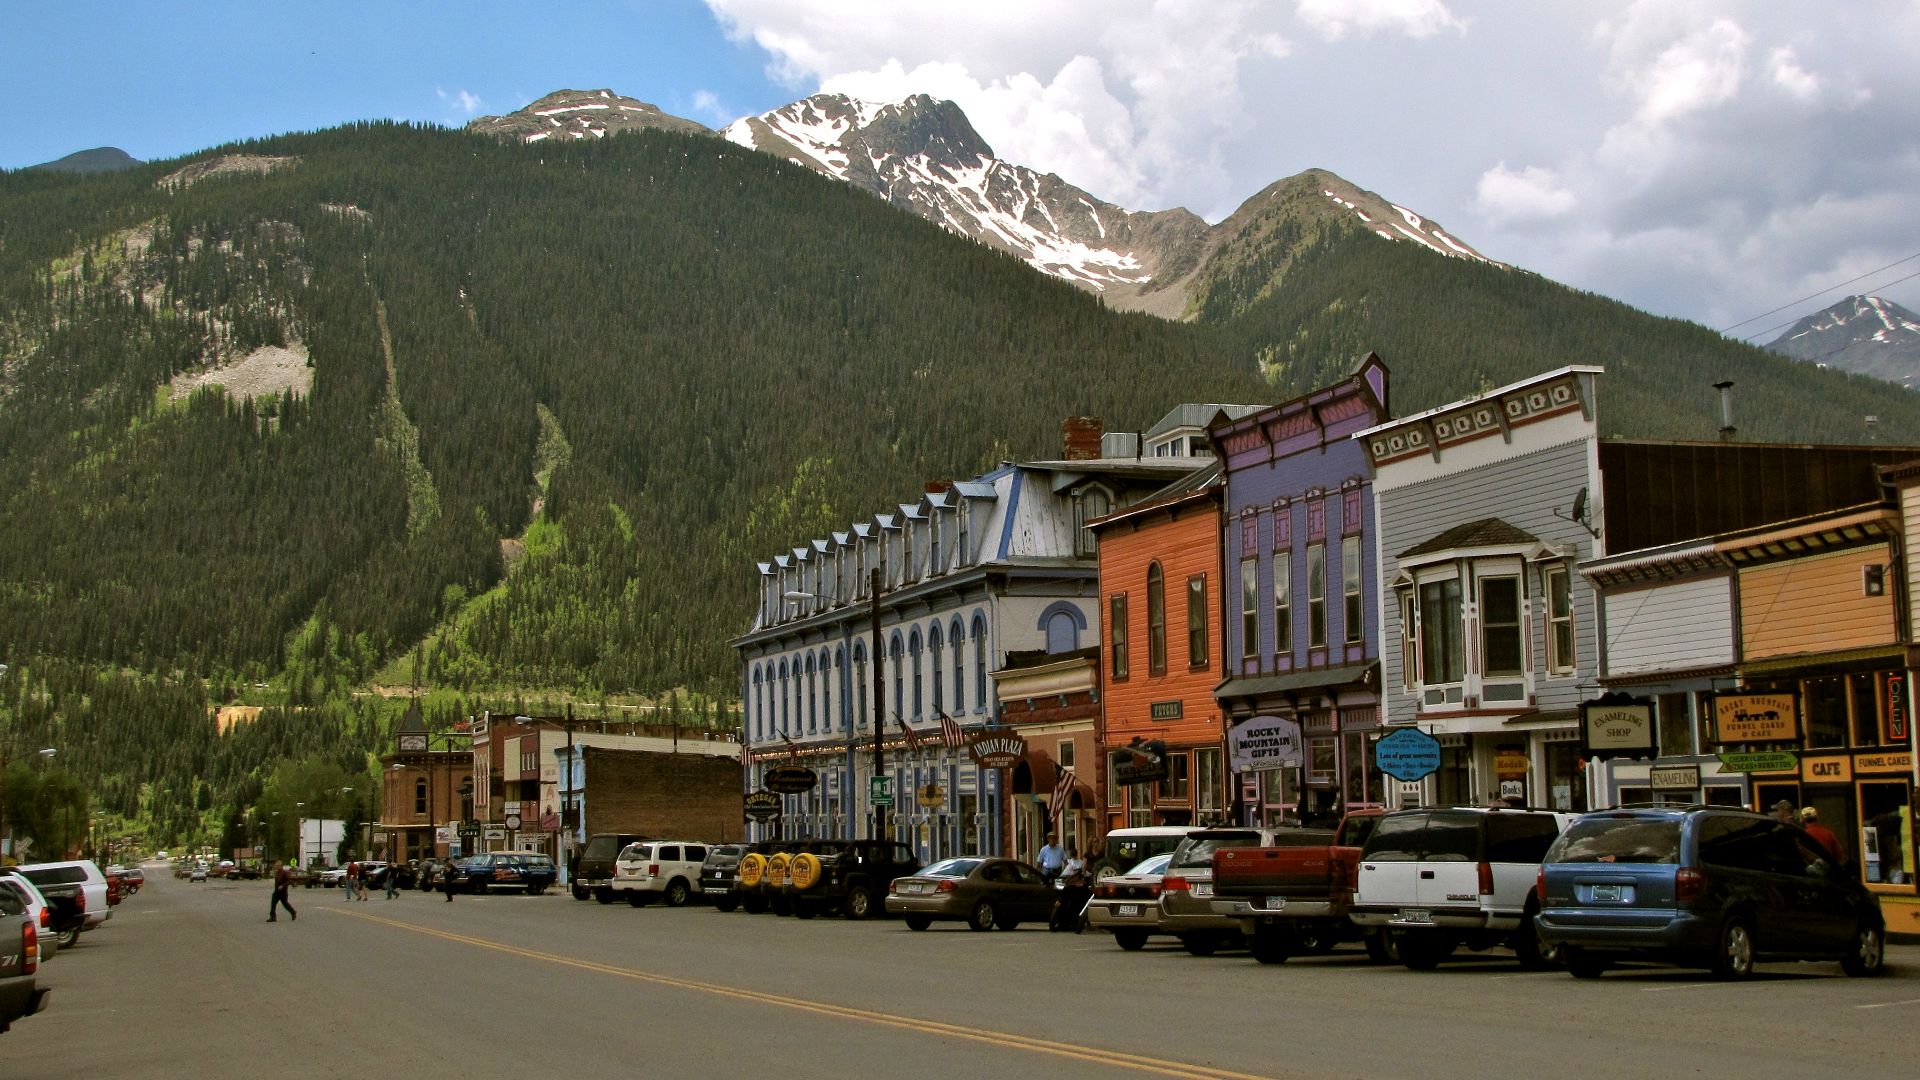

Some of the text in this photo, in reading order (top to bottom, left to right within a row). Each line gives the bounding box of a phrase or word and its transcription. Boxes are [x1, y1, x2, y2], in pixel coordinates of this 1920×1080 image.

[1719, 697, 1791, 715] ROCKY MOUNTAIN
[1891, 681, 1901, 735] OPEN
[1593, 711, 1643, 728] ENAMELING
[1727, 721, 1785, 730] FUNNEL CAKES
[1246, 726, 1281, 738] ROCKY
[1606, 728, 1631, 737] SHOP
[973, 738, 1023, 758] INDIAN PLAZA
[1239, 737, 1290, 749] MOUNTAIN
[1251, 748, 1280, 758] GIFTS
[1497, 760, 1523, 769] Kodak
[1859, 756, 1910, 767] FUNNEL CAKES
[1812, 762, 1840, 775] CAFE
[1653, 772, 1696, 786] ENAMELING
[1502, 784, 1522, 795] Books
